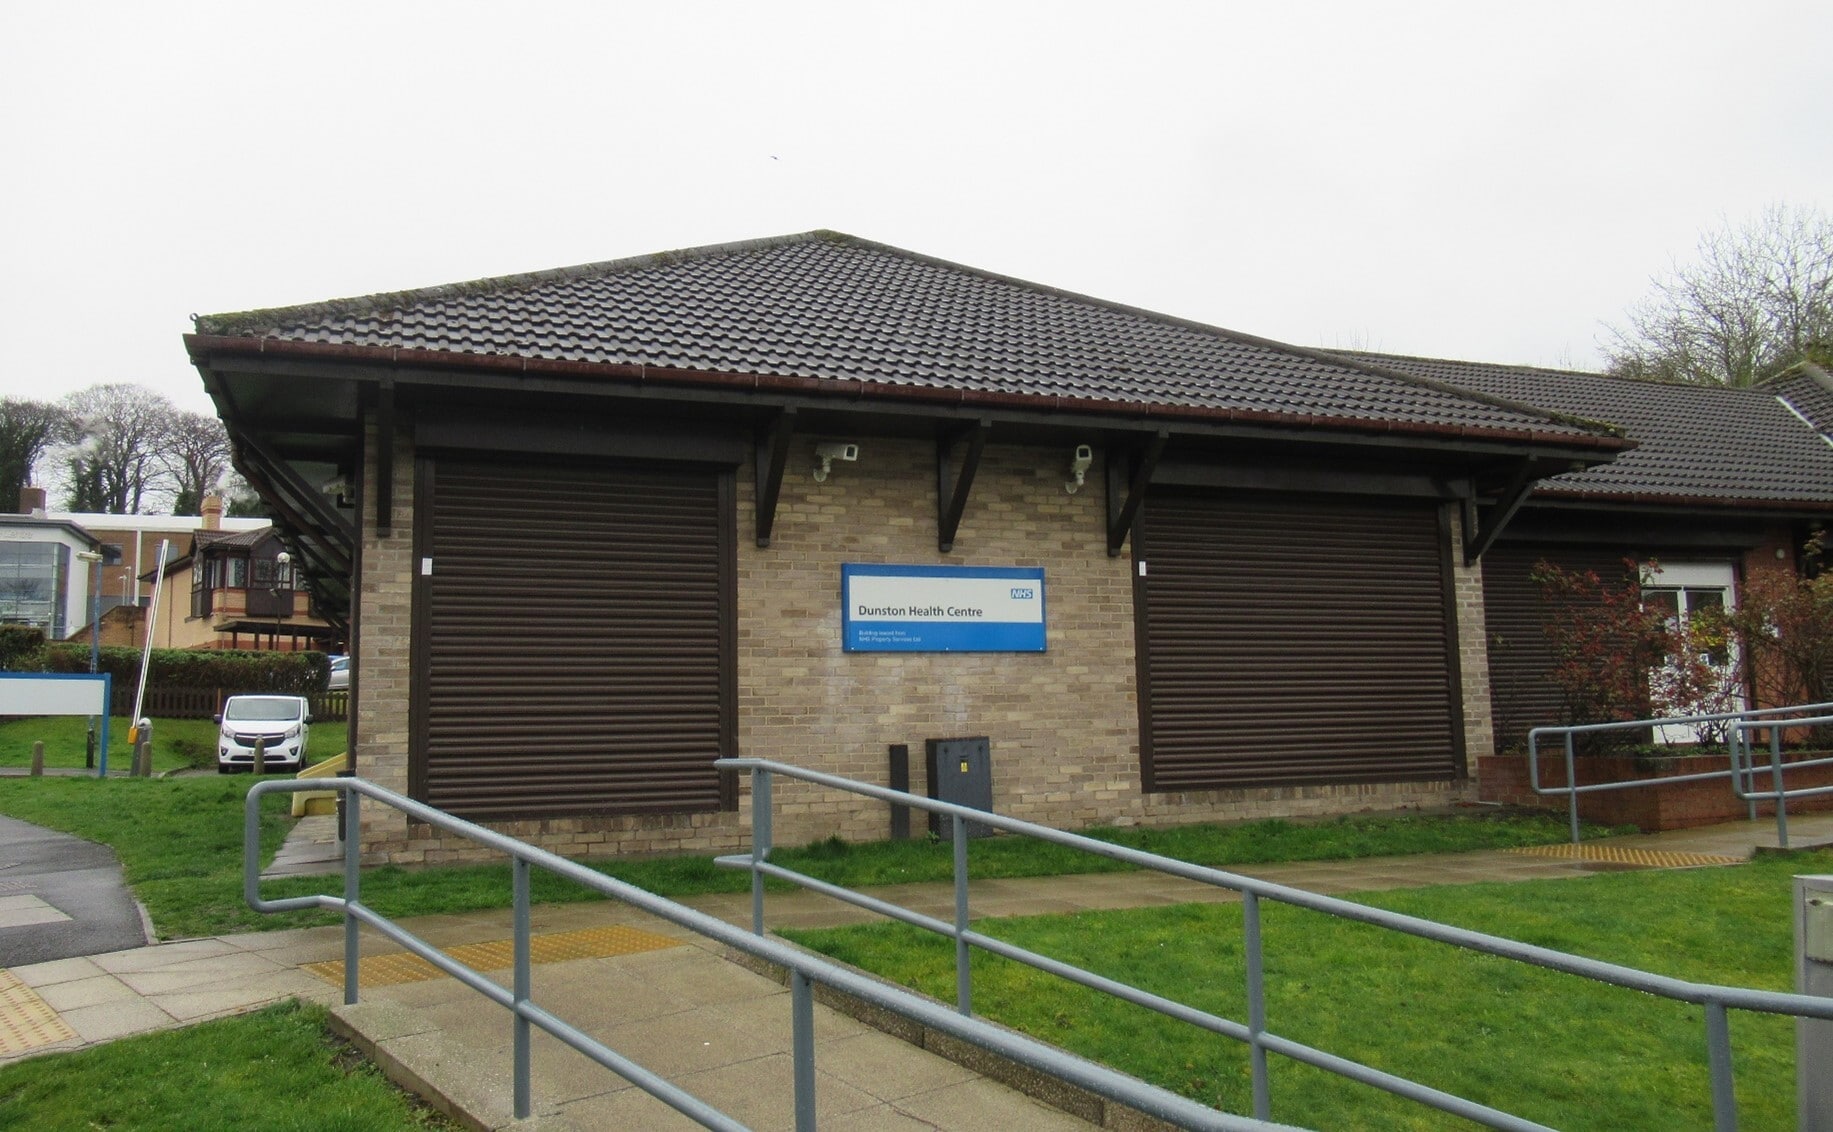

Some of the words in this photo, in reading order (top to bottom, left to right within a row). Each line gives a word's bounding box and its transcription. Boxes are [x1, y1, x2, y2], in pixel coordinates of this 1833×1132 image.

[1011, 589, 1033, 599] NHS
[858, 605, 906, 616] Dunston
[909, 606, 944, 617] Health
[947, 606, 983, 617] Centre
